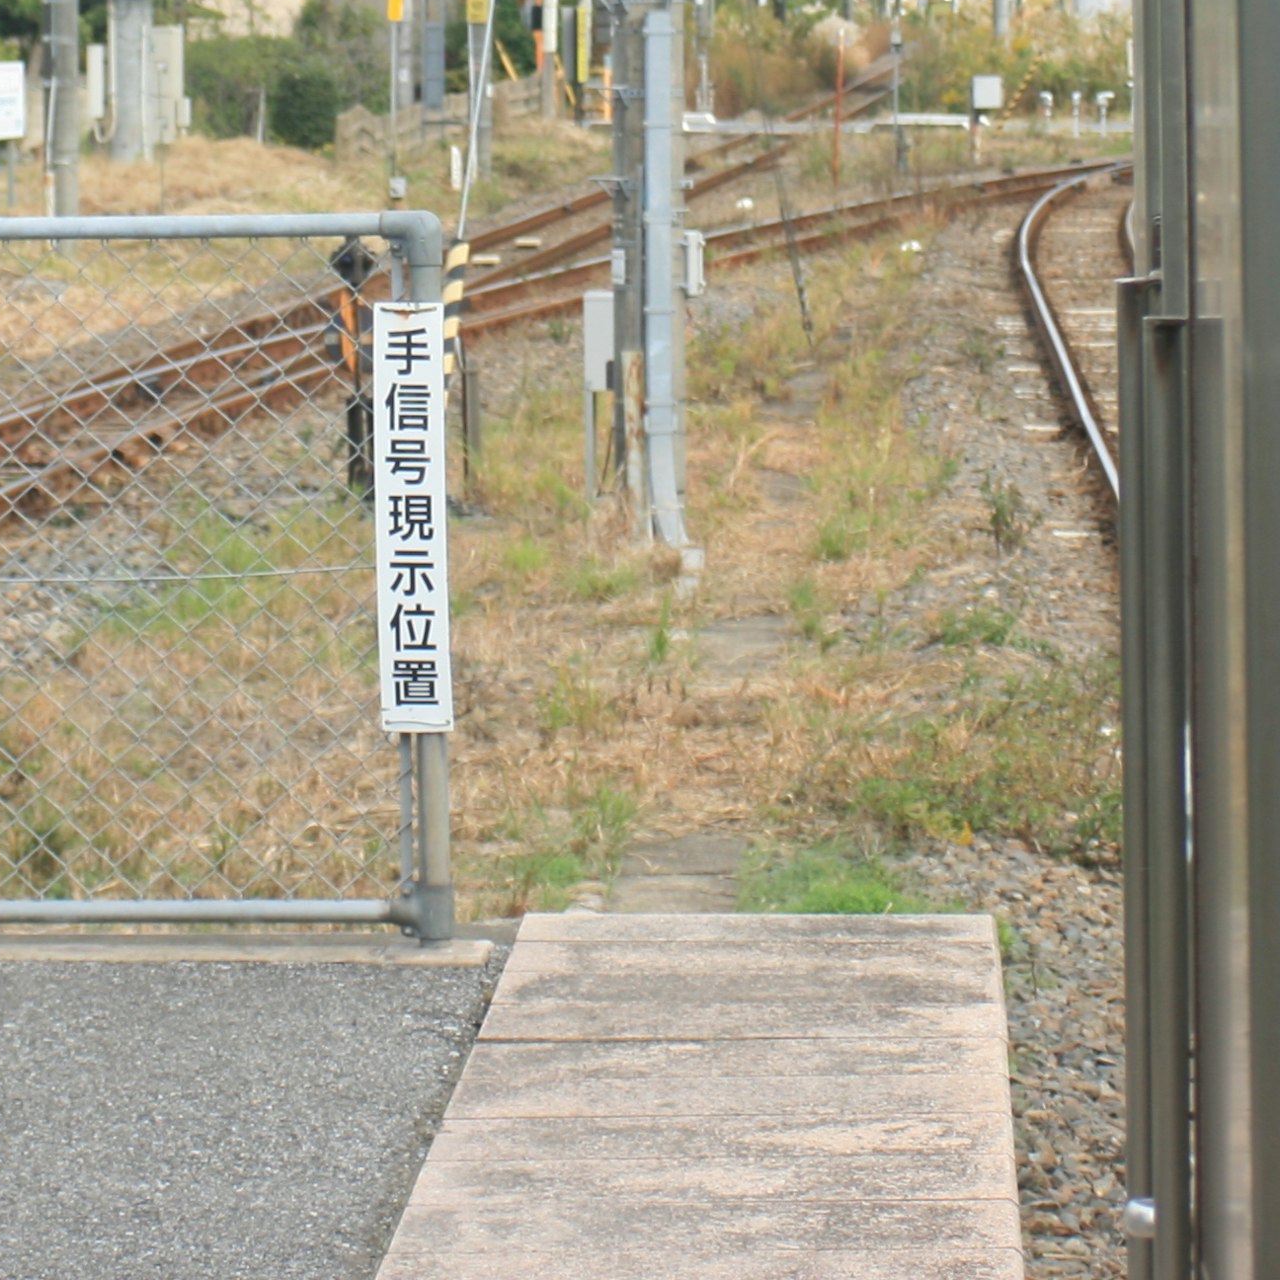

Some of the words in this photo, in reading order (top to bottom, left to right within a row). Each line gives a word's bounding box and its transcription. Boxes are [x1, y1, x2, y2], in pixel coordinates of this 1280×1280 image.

[385, 328, 439, 706] 手信号現示位置
